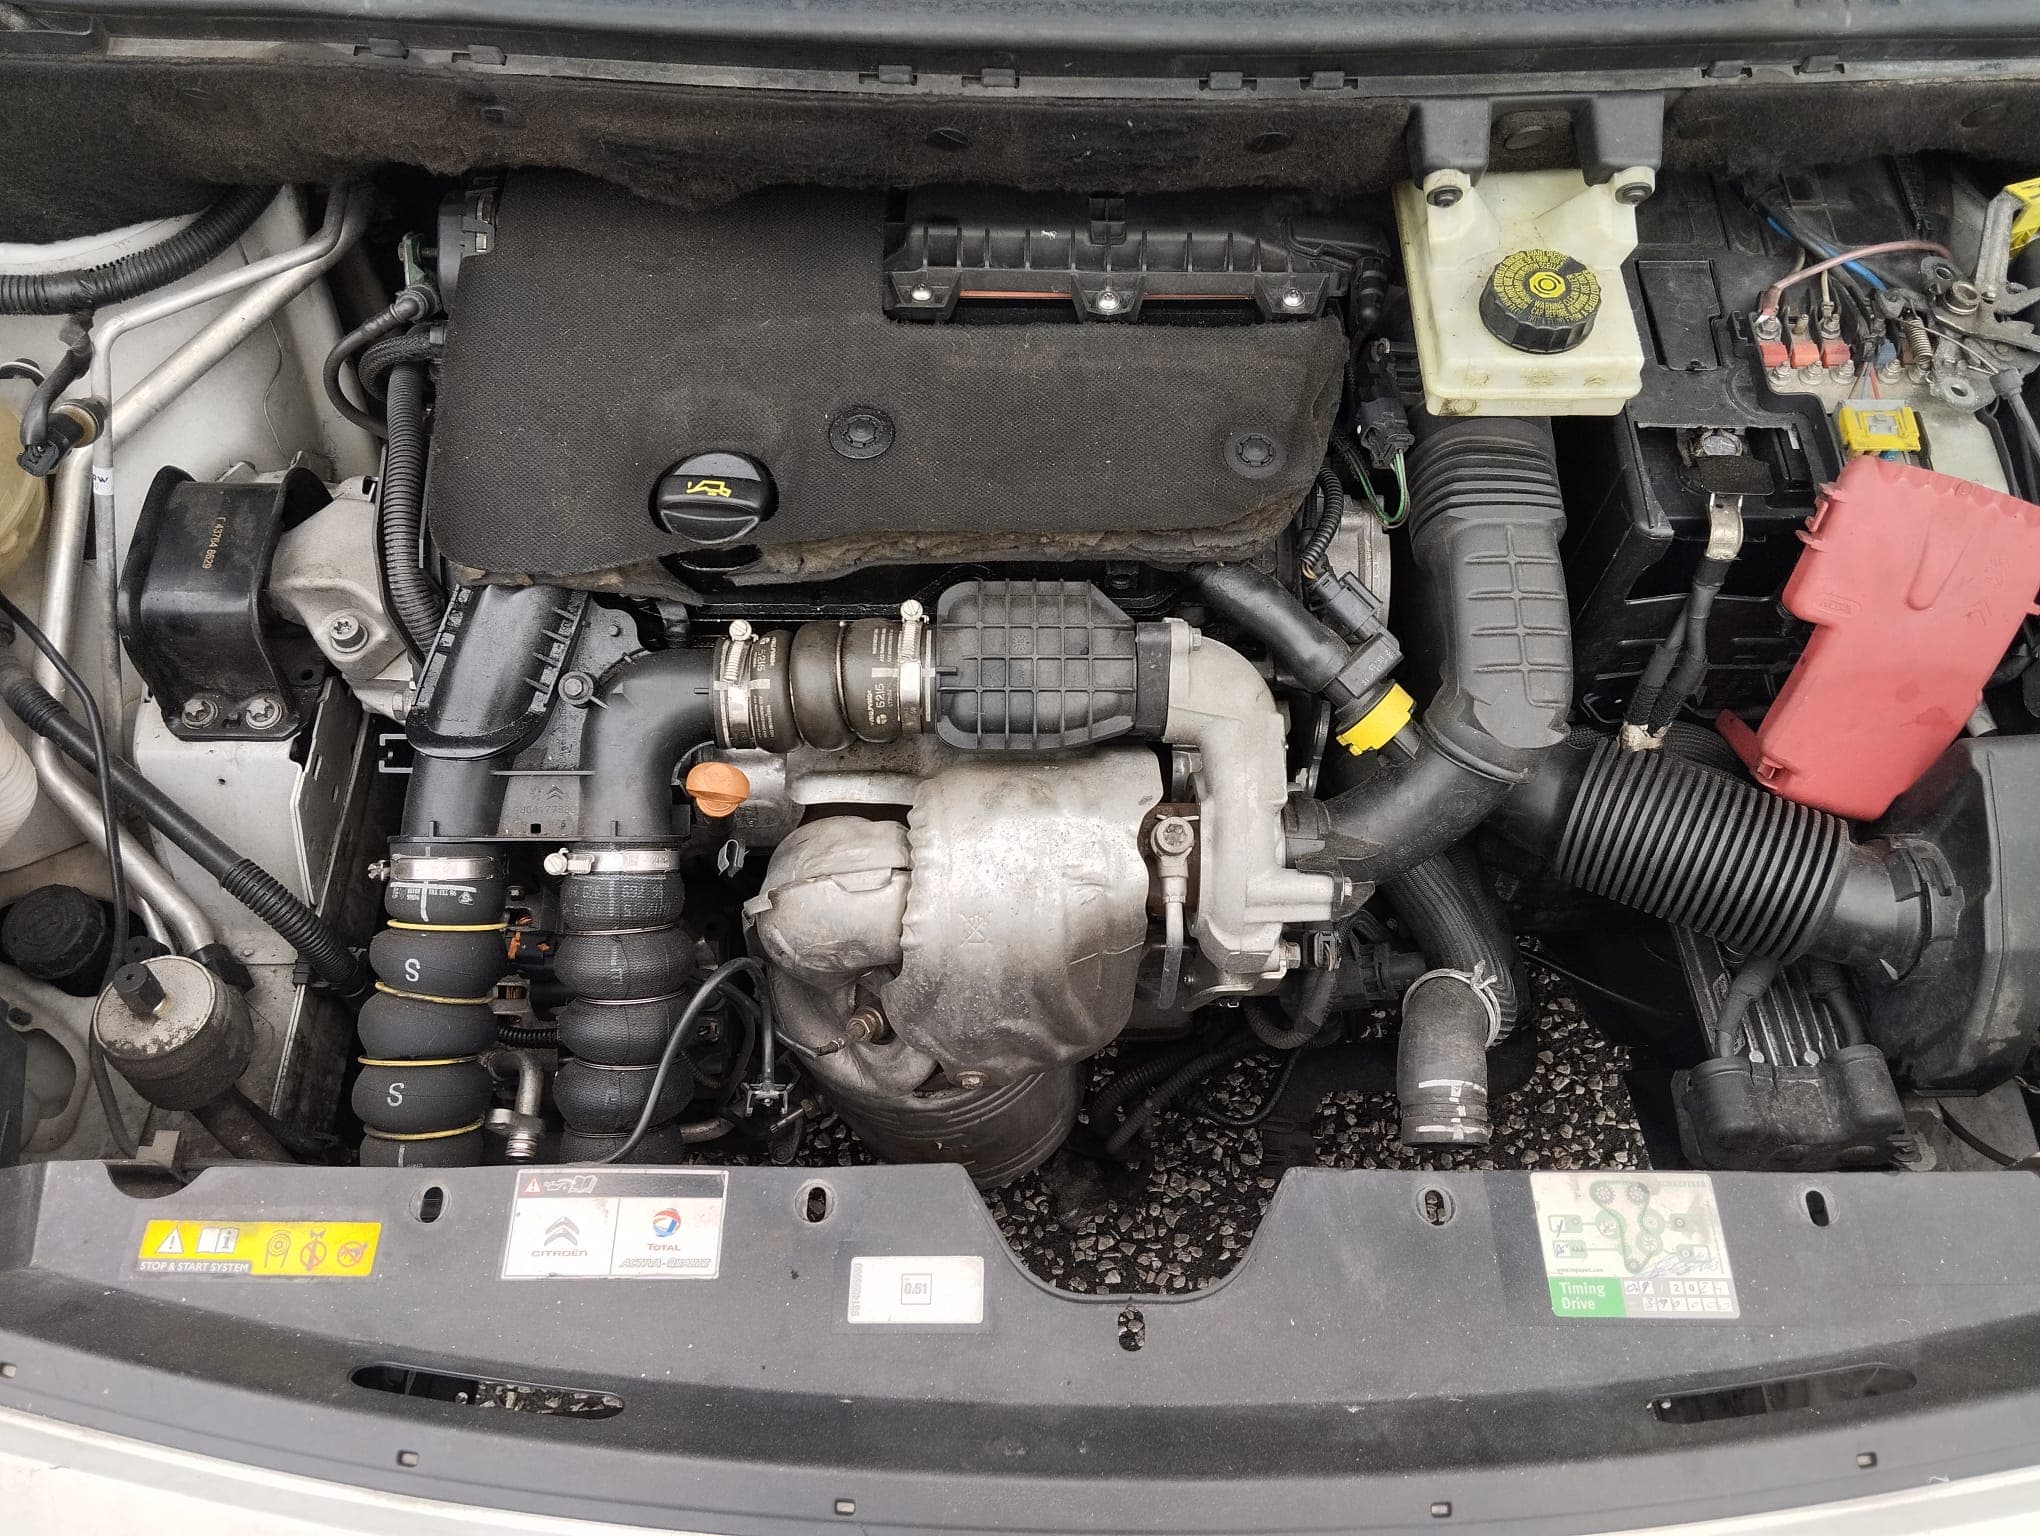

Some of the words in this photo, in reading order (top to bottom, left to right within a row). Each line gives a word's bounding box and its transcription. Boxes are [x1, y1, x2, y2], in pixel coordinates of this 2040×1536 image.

[405, 958, 420, 982] S
[387, 1082, 405, 1107] S
[140, 1261, 167, 1271] STOP
[168, 1262, 176, 1271] &
[177, 1262, 209, 1272] START
[210, 1263, 249, 1273] SYSTEM
[1559, 1281, 1606, 1297] Timing
[1561, 1296, 1597, 1311] Drive
